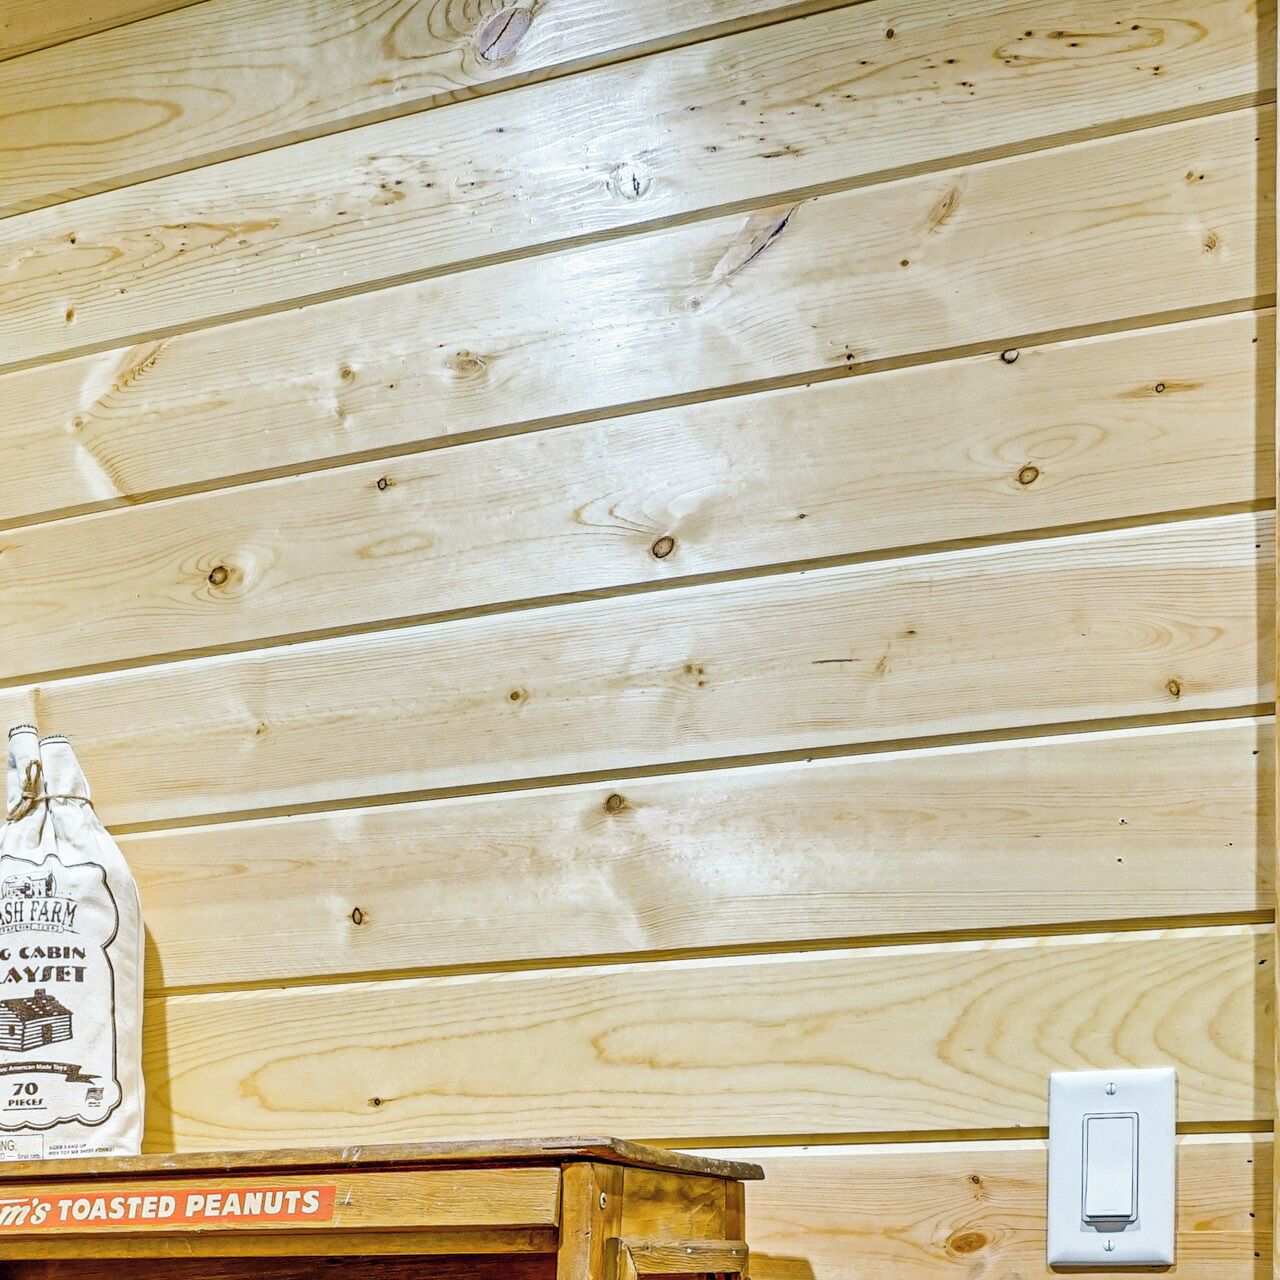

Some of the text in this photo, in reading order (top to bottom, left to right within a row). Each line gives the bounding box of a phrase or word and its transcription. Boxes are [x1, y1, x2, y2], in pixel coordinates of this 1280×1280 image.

[30, 901, 78, 927] FARM
[19, 946, 86, 960] CABIN
[52, 1064, 68, 1072] Toys
[12, 1081, 39, 1096] 70
[8, 1098, 43, 1107] PIECES
[58, 1196, 176, 1221] TOASTED
[185, 1190, 320, 1217] PEANUTS
